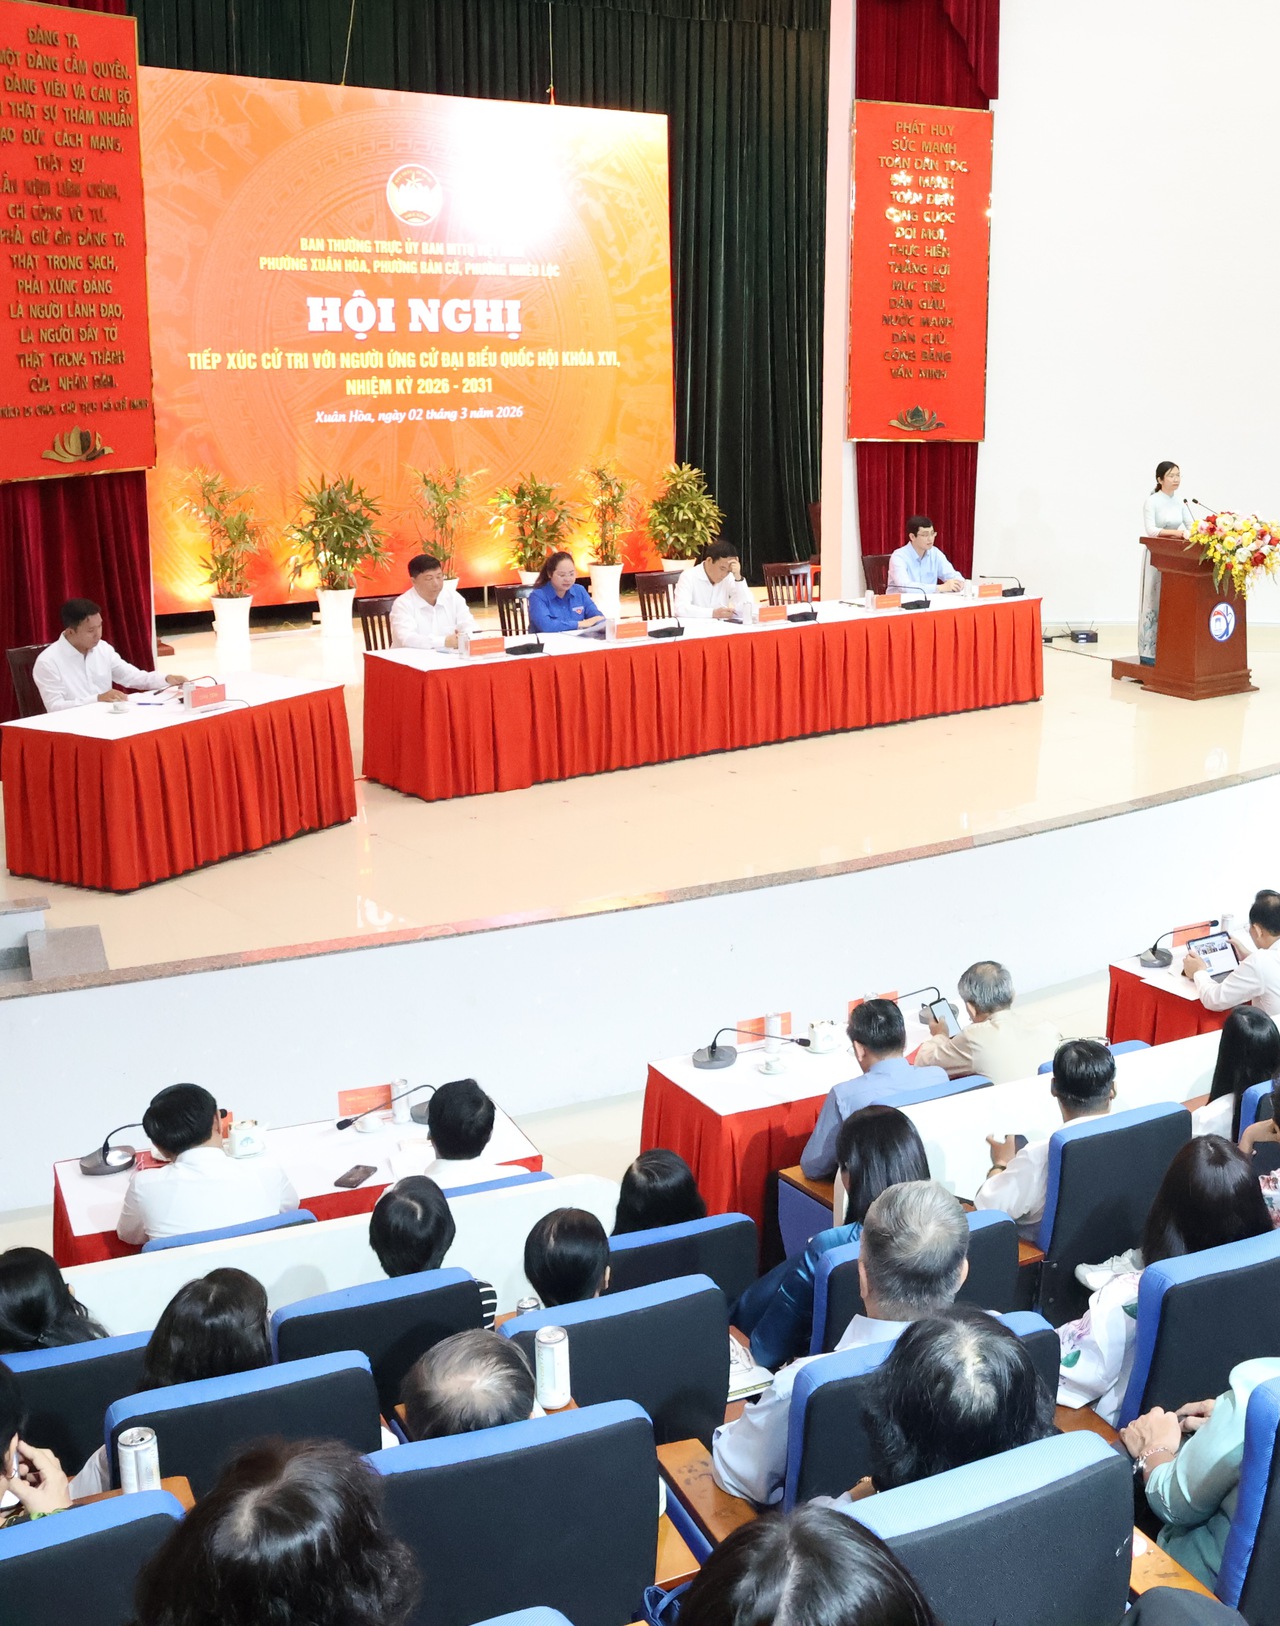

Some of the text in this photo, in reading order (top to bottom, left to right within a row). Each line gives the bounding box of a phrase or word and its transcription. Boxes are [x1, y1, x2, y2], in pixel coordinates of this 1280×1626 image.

[65, 33, 79, 48] TA
[72, 81, 86, 100] VÀ
[0, 127, 15, 146] ẠO
[895, 119, 955, 137] PHÁT HUY
[113, 231, 126, 247] TA
[300, 237, 325, 252] BAN
[327, 236, 372, 253] THƯỜNG
[374, 240, 403, 257] TRỰC
[421, 242, 444, 255] BAN
[45, 255, 83, 270] TRONG
[259, 253, 308, 271] PHƯỜNG
[310, 256, 342, 272] XUÂN
[373, 257, 418, 274] PHƯỜNG
[9, 300, 24, 319] LÀ
[306, 289, 523, 340] HỘI NGHỊ
[20, 326, 35, 343] LÀ
[188, 345, 621, 371] TIẾP XÚC CỬ TRI VỚI NGƯỜI ỨNG CỬ ĐẠI BIỂU QUỐC HỘI KHÓA XVI,
[345, 375, 392, 398] NHIỆM
[395, 375, 414, 395] KỲ
[416, 377, 450, 394] 2026
[462, 377, 493, 393] 2031
[315, 406, 523, 423] Xuân Hòa, ngày 02 tháng 3 năm 2026
